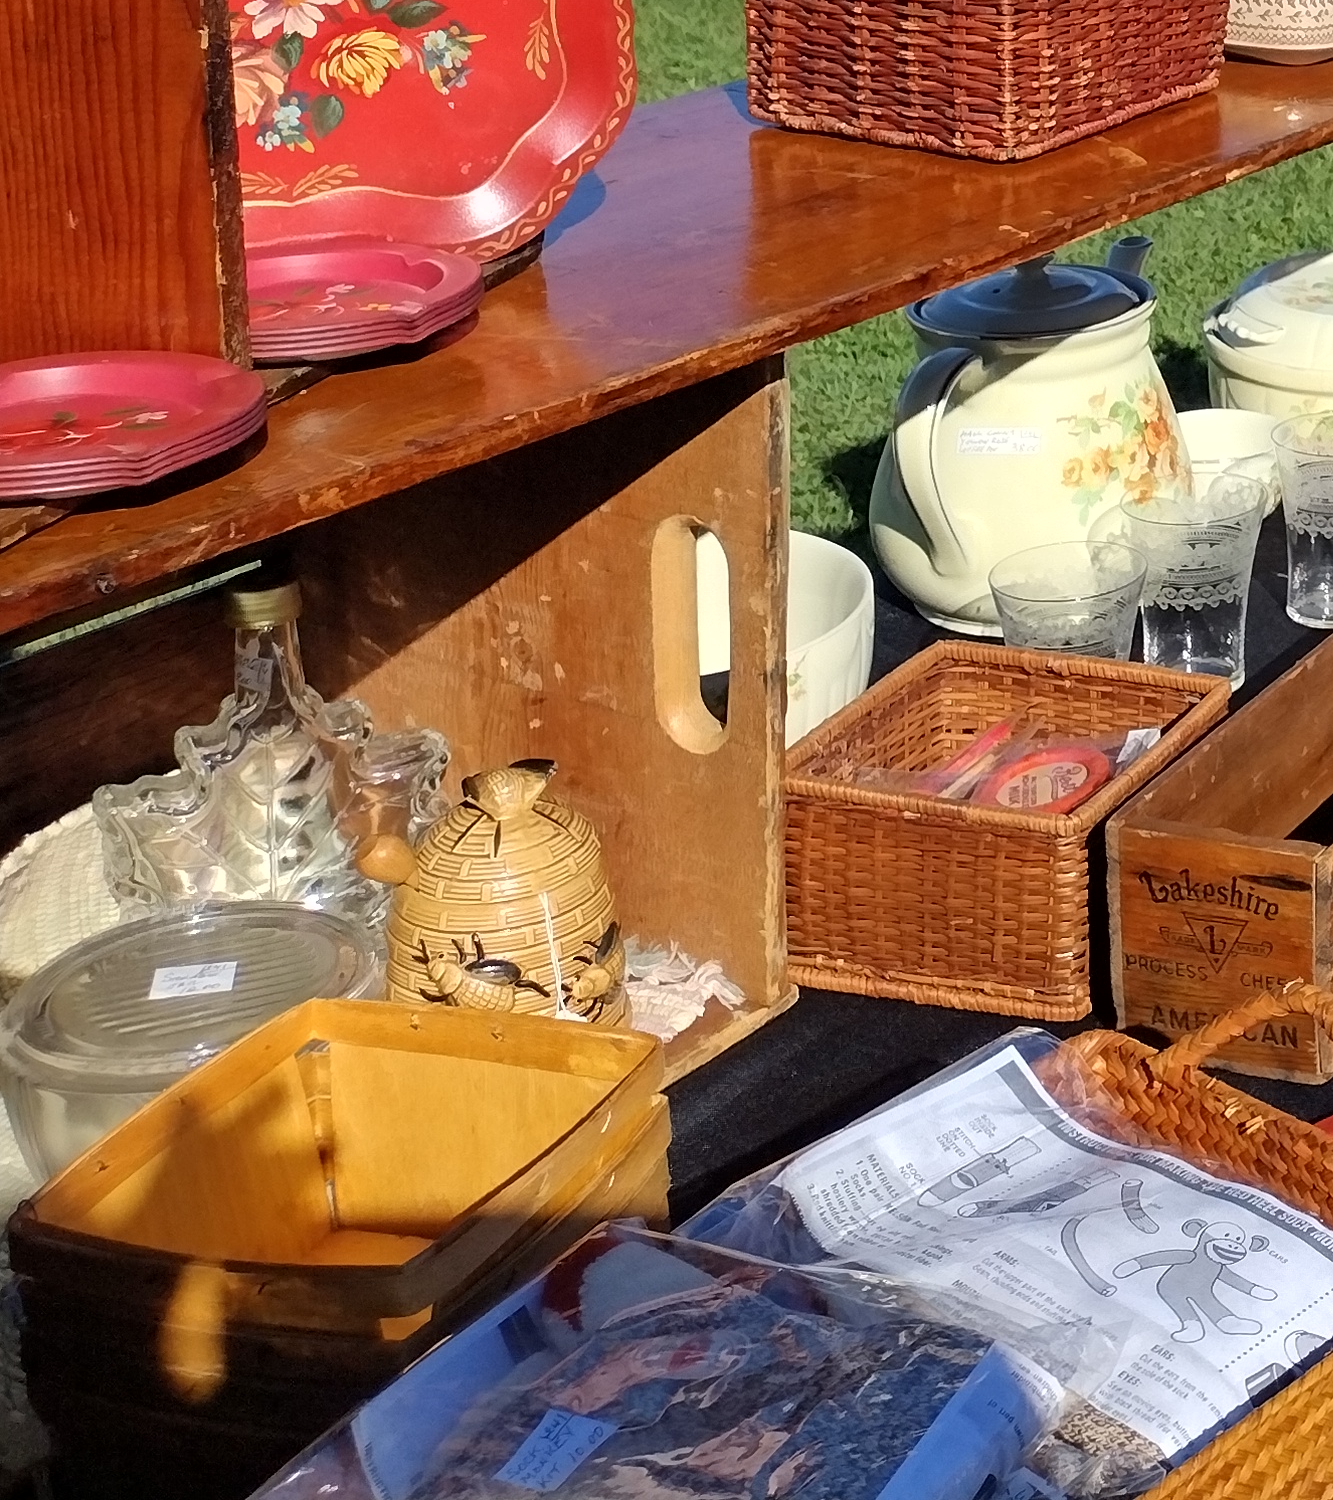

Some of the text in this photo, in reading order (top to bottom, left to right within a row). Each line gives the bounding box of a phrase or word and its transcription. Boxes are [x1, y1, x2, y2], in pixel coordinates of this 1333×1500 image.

[1138, 869, 1279, 920] Lakeshire
[1124, 954, 1208, 981] PROCESS
[1151, 1005, 1298, 1048] AMEAN
[938, 1132, 967, 1158] DOTTED
[951, 1126, 977, 1149] STITCH
[858, 1168, 874, 1186] One
[869, 1186, 885, 1203] pair
[905, 1162, 924, 1185] SOCK
[1159, 1156, 1202, 1190] MAKING
[1248, 1189, 1280, 1218] HEEL
[1277, 1207, 1311, 1233] SOCK
[992, 1247, 1020, 1269] ARMS:
[1150, 1342, 1175, 1364] EARS:
[1117, 1368, 1142, 1390] EYES:
[1151, 1360, 1164, 1372] the
[1179, 1378, 1196, 1393] from
[1195, 1390, 1208, 1402] the
[506, 1445, 541, 1480] SOCK
